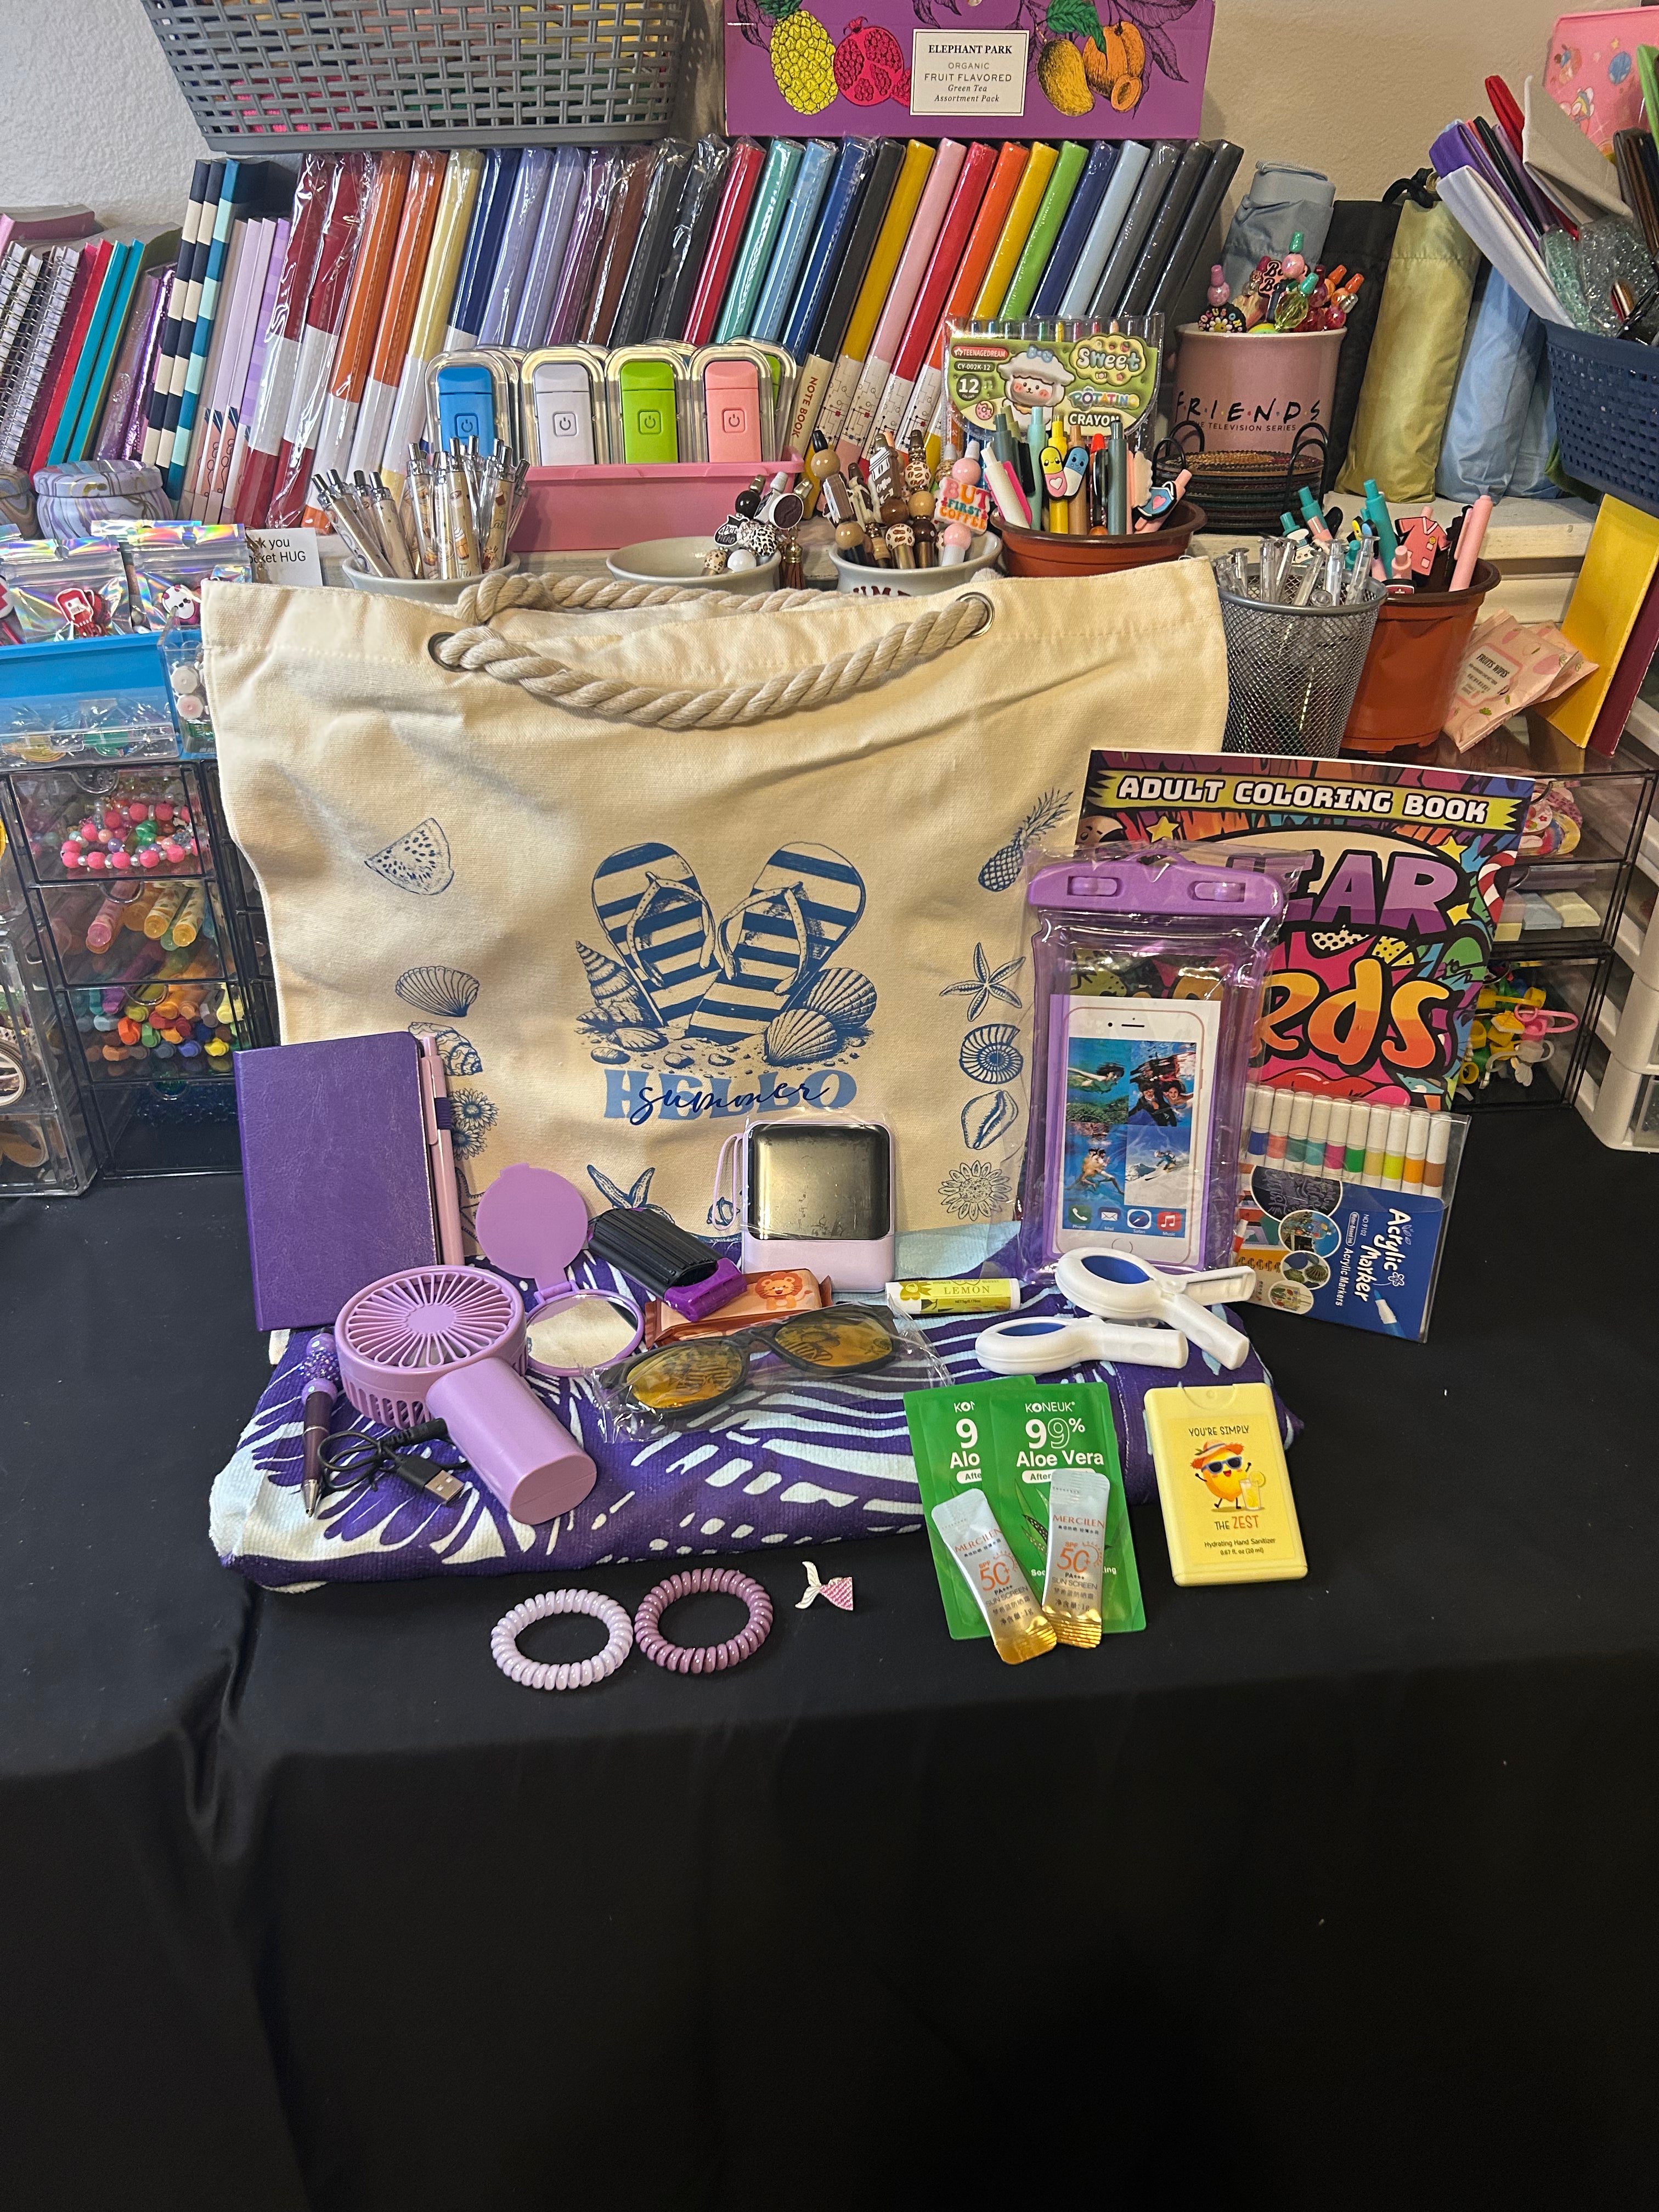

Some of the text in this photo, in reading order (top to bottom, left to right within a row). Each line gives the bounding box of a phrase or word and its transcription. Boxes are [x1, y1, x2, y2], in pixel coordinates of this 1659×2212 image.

[929, 44, 1012, 54] ELEPHANT PARK
[924, 73, 1012, 82] FRUIT FLAVORED
[963, 348, 1006, 358] TEENAGEDREAM
[1076, 347, 1141, 372] Sweet
[958, 378, 979, 393] 12
[792, 376, 818, 438] NOTE BOOK
[1175, 391, 1322, 424] FRIENDS
[1208, 422, 1262, 431] TELEVISION
[943, 477, 992, 510] BUT
[947, 499, 981, 517] FIRST
[939, 506, 986, 530] COFFEE
[269, 539, 290, 550] you
[280, 550, 306, 562] HUG
[1476, 653, 1496, 668] FRUITS
[1118, 777, 1489, 823] ADULT COLORING BOOK
[603, 1069, 857, 1120] HELLO
[1360, 1214, 1370, 1237] NO.9102
[1373, 1208, 1412, 1271] Acrylic
[1335, 1247, 1354, 1307] Acrylic Markers
[1354, 1245, 1381, 1302] Marker
[944, 1285, 990, 1295] LEMON
[1025, 1417, 1086, 1449] 99%
[1188, 1425, 1249, 1437] YOU'RE SIMPLY
[950, 1450, 980, 1469] Alo
[1016, 1449, 1104, 1468] Aloe Vera
[964, 1472, 982, 1481] Afte
[1052, 1514, 1105, 1528] MERCILEN
[1214, 1514, 1259, 1531] THE ZEST
[1052, 1576, 1098, 1590] SUN SCREEN
[985, 1596, 1000, 1607] SUN
[1000, 1585, 1029, 1601] SCREEN
